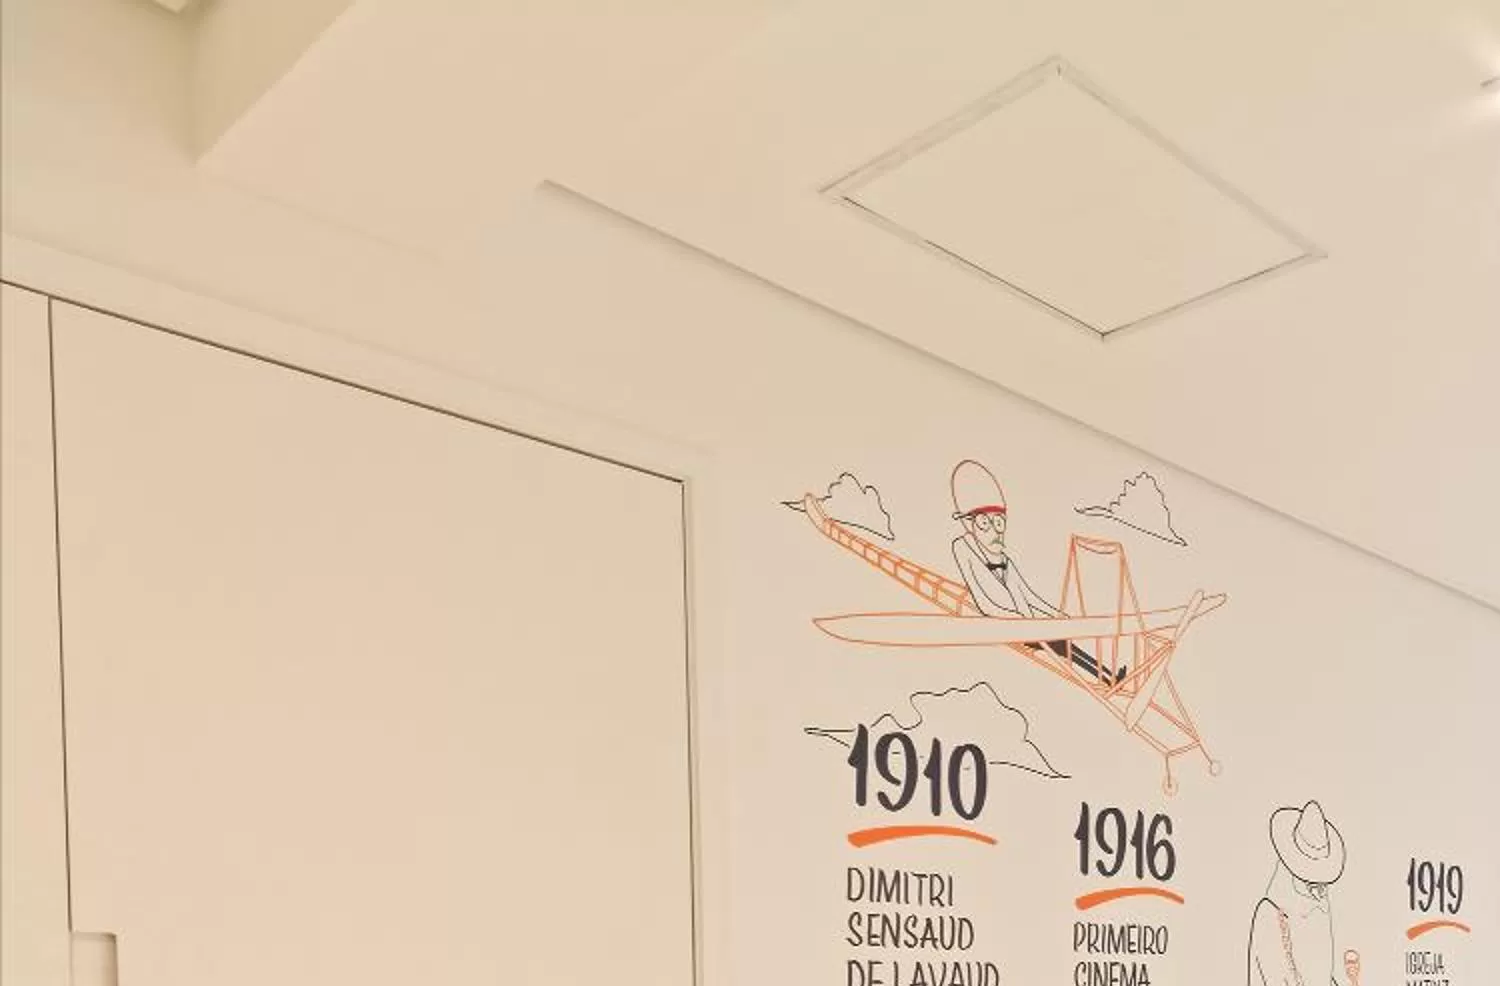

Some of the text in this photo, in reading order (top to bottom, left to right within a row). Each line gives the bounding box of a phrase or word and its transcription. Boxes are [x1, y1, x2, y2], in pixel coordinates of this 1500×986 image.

[847, 723, 988, 821] 1910
[1074, 801, 1177, 882] 1916
[846, 867, 954, 907] DIMITRI
[1407, 857, 1464, 915] 1919
[845, 911, 976, 951] SENSAUD
[1073, 921, 1169, 956] PRIMEIRO
[1405, 951, 1445, 976] IGREJA
